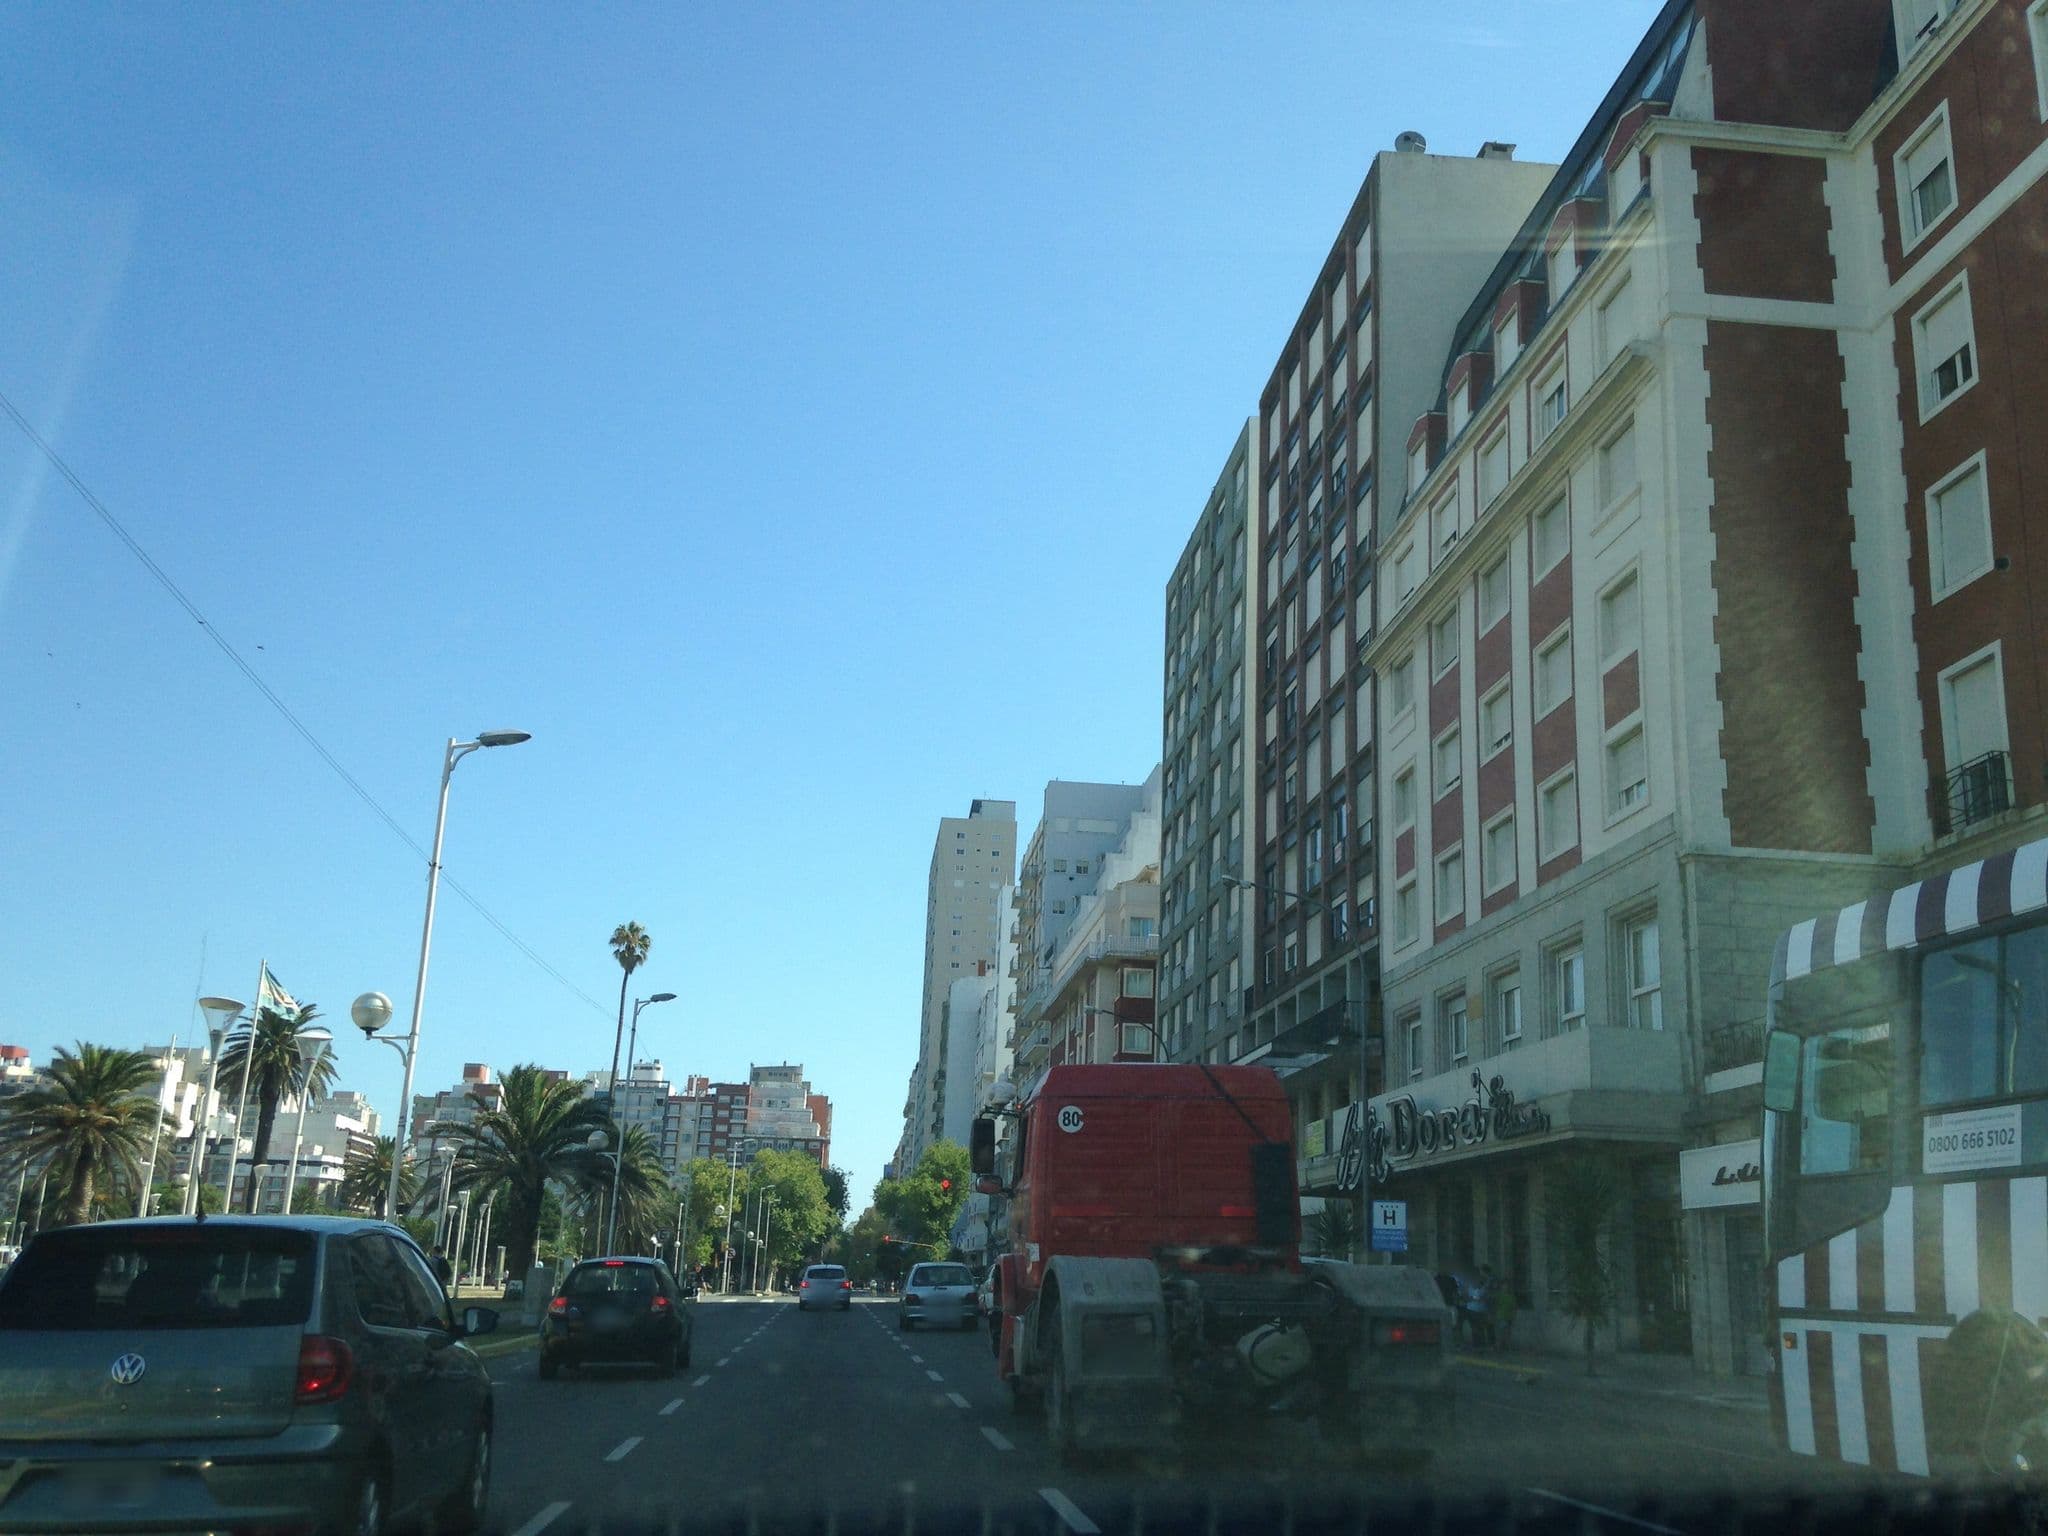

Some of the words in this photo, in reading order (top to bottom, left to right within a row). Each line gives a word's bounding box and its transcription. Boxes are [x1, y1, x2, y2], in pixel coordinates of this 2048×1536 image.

[1063, 1111, 1080, 1127] 80
[1928, 1134, 1958, 1153] 0800
[1961, 1131, 1984, 1150] 666
[1987, 1127, 2016, 1147] 5102
[1383, 1209, 1396, 1225] H
